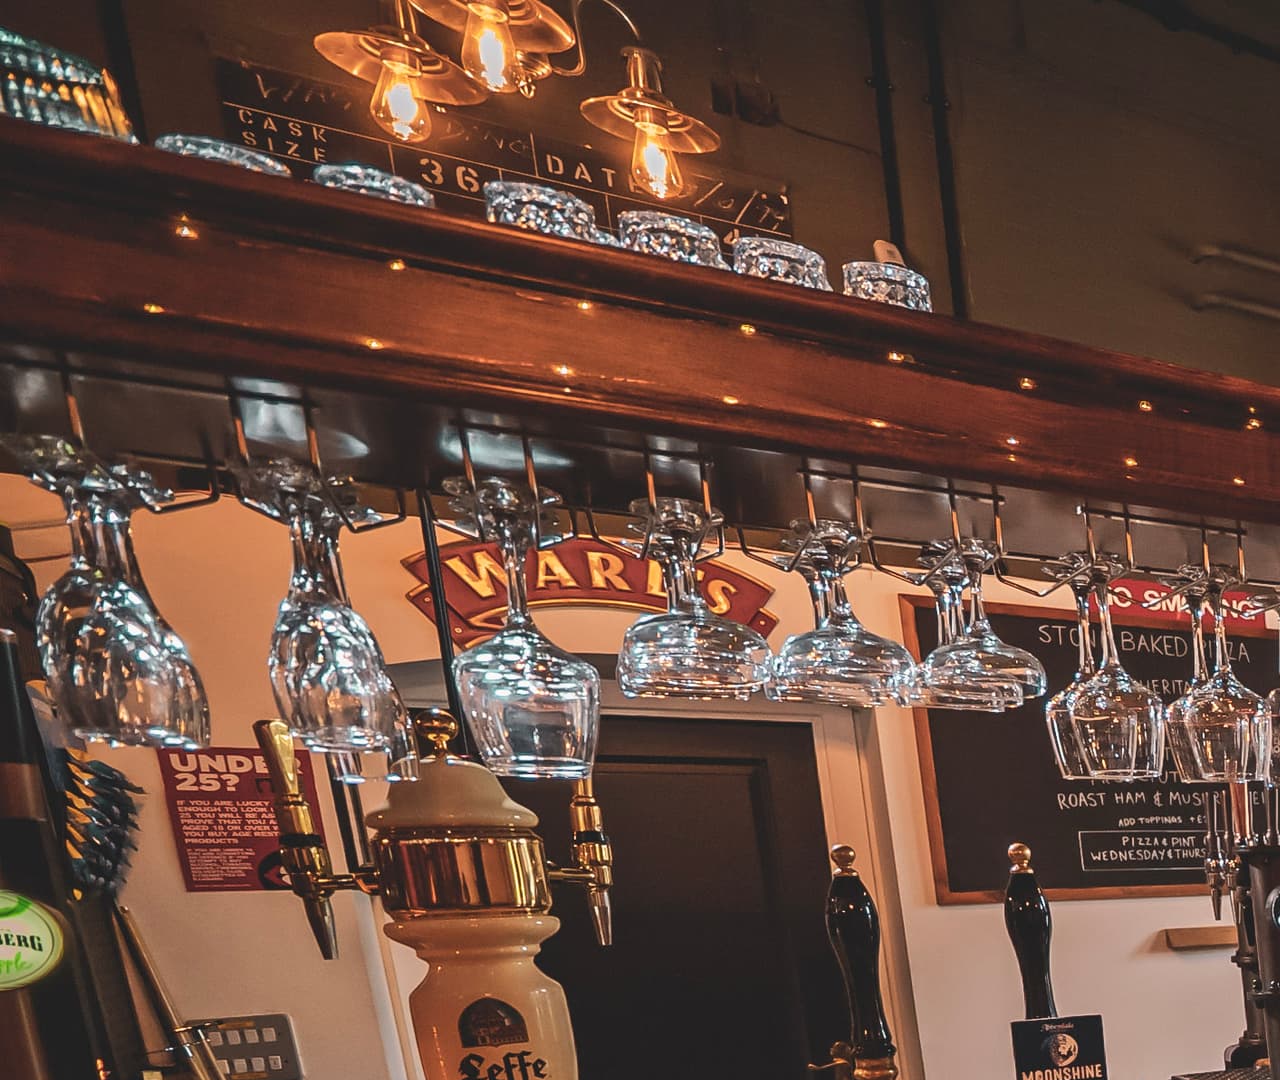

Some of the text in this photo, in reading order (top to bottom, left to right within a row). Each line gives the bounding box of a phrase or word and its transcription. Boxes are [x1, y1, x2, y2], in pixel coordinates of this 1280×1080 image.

[238, 109, 327, 143] CASK
[241, 130, 327, 162] SIZE
[419, 158, 480, 193] 36
[1121, 631, 1188, 658] BAKED
[174, 773, 240, 792] 25?
[1057, 792, 1106, 809] ROAST
[1115, 792, 1146, 805] HAM
[1118, 816, 1136, 827] ADD
[1137, 815, 1182, 825] TOPPINGS
[1121, 836, 1159, 847] PIZZA
[1171, 836, 1196, 847] PINT
